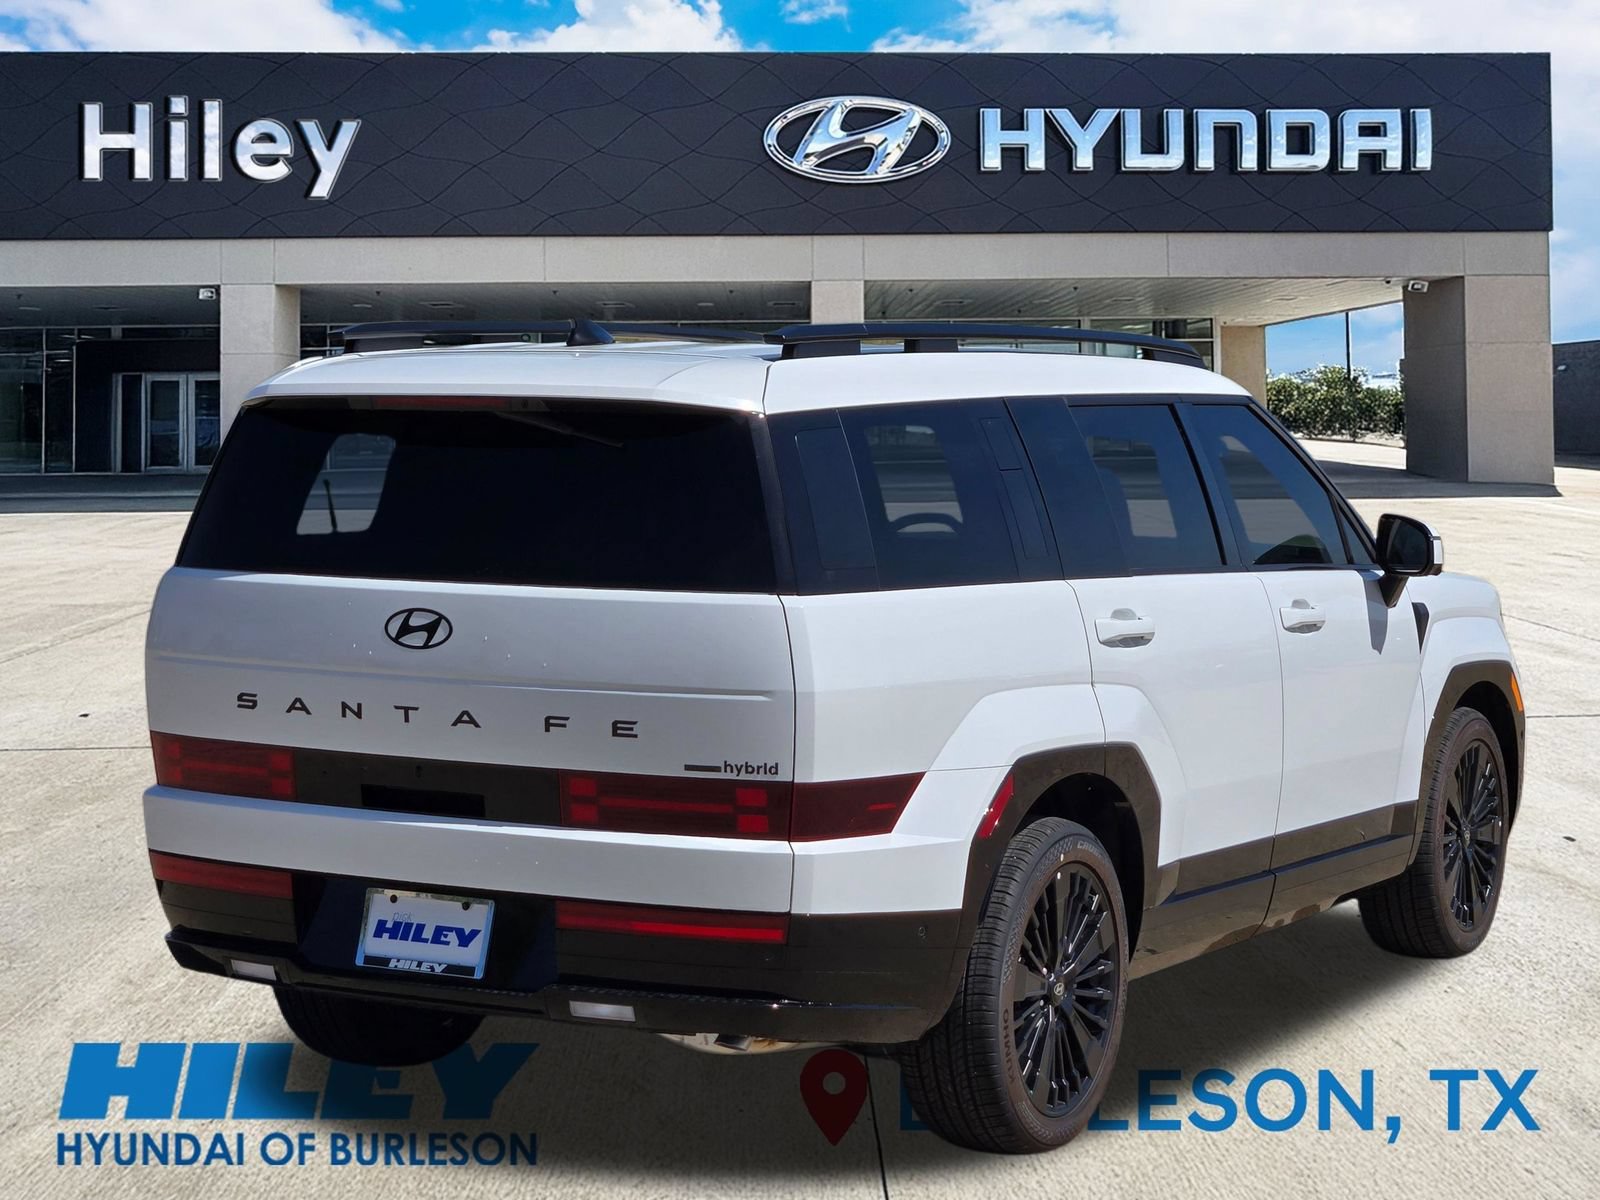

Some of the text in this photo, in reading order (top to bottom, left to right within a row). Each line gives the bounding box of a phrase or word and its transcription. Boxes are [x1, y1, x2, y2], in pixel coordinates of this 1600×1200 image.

[80, 95, 361, 199] Hiley
[980, 107, 1433, 172] HYUNDAI
[237, 692, 640, 738] SANTA FE
[723, 760, 779, 777] hybrid
[374, 920, 481, 947] HILEY
[389, 959, 448, 973] HILEY
[1003, 1008, 1016, 1083] KUMHO
